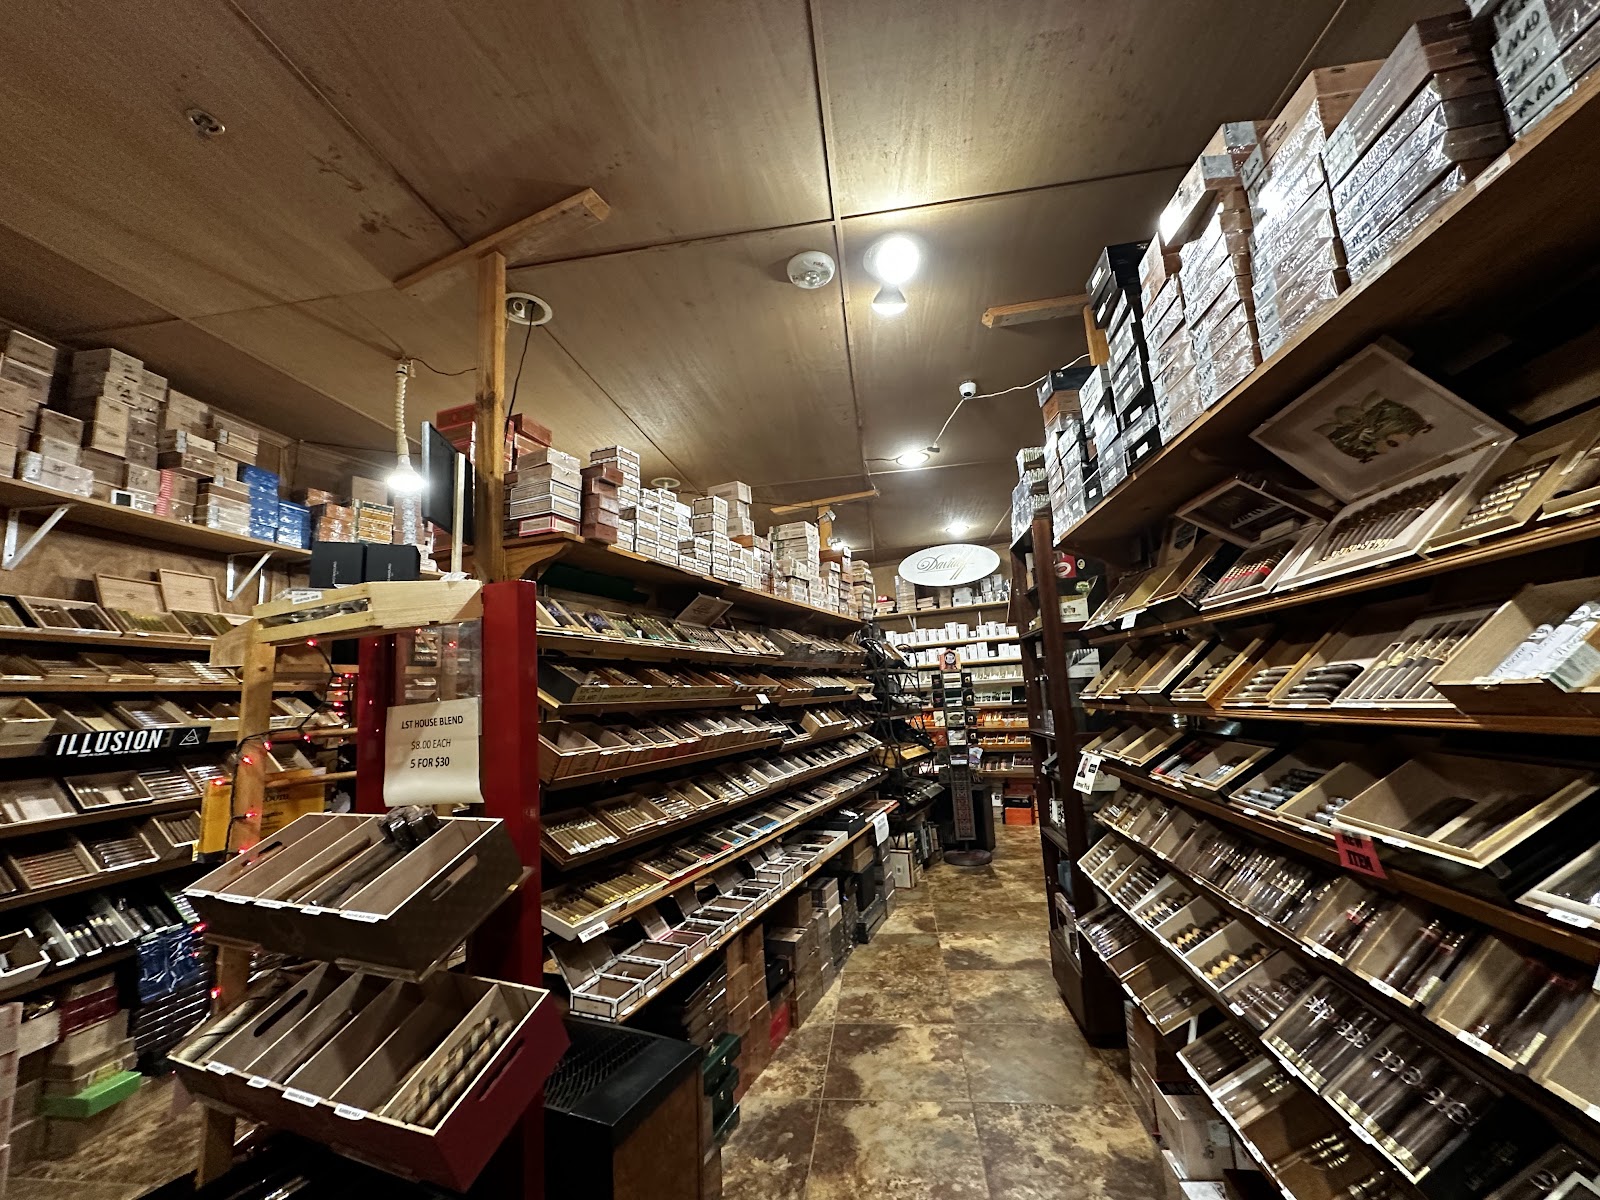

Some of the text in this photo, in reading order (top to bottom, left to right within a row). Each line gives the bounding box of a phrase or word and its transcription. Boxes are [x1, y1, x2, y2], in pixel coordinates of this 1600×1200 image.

[414, 717, 438, 728] HOUSE
[439, 715, 464, 726] BLEND
[411, 738, 452, 751] $8.00 EACH
[410, 756, 450, 769] 5 FOR $30
[1345, 849, 1375, 872] ITEM
